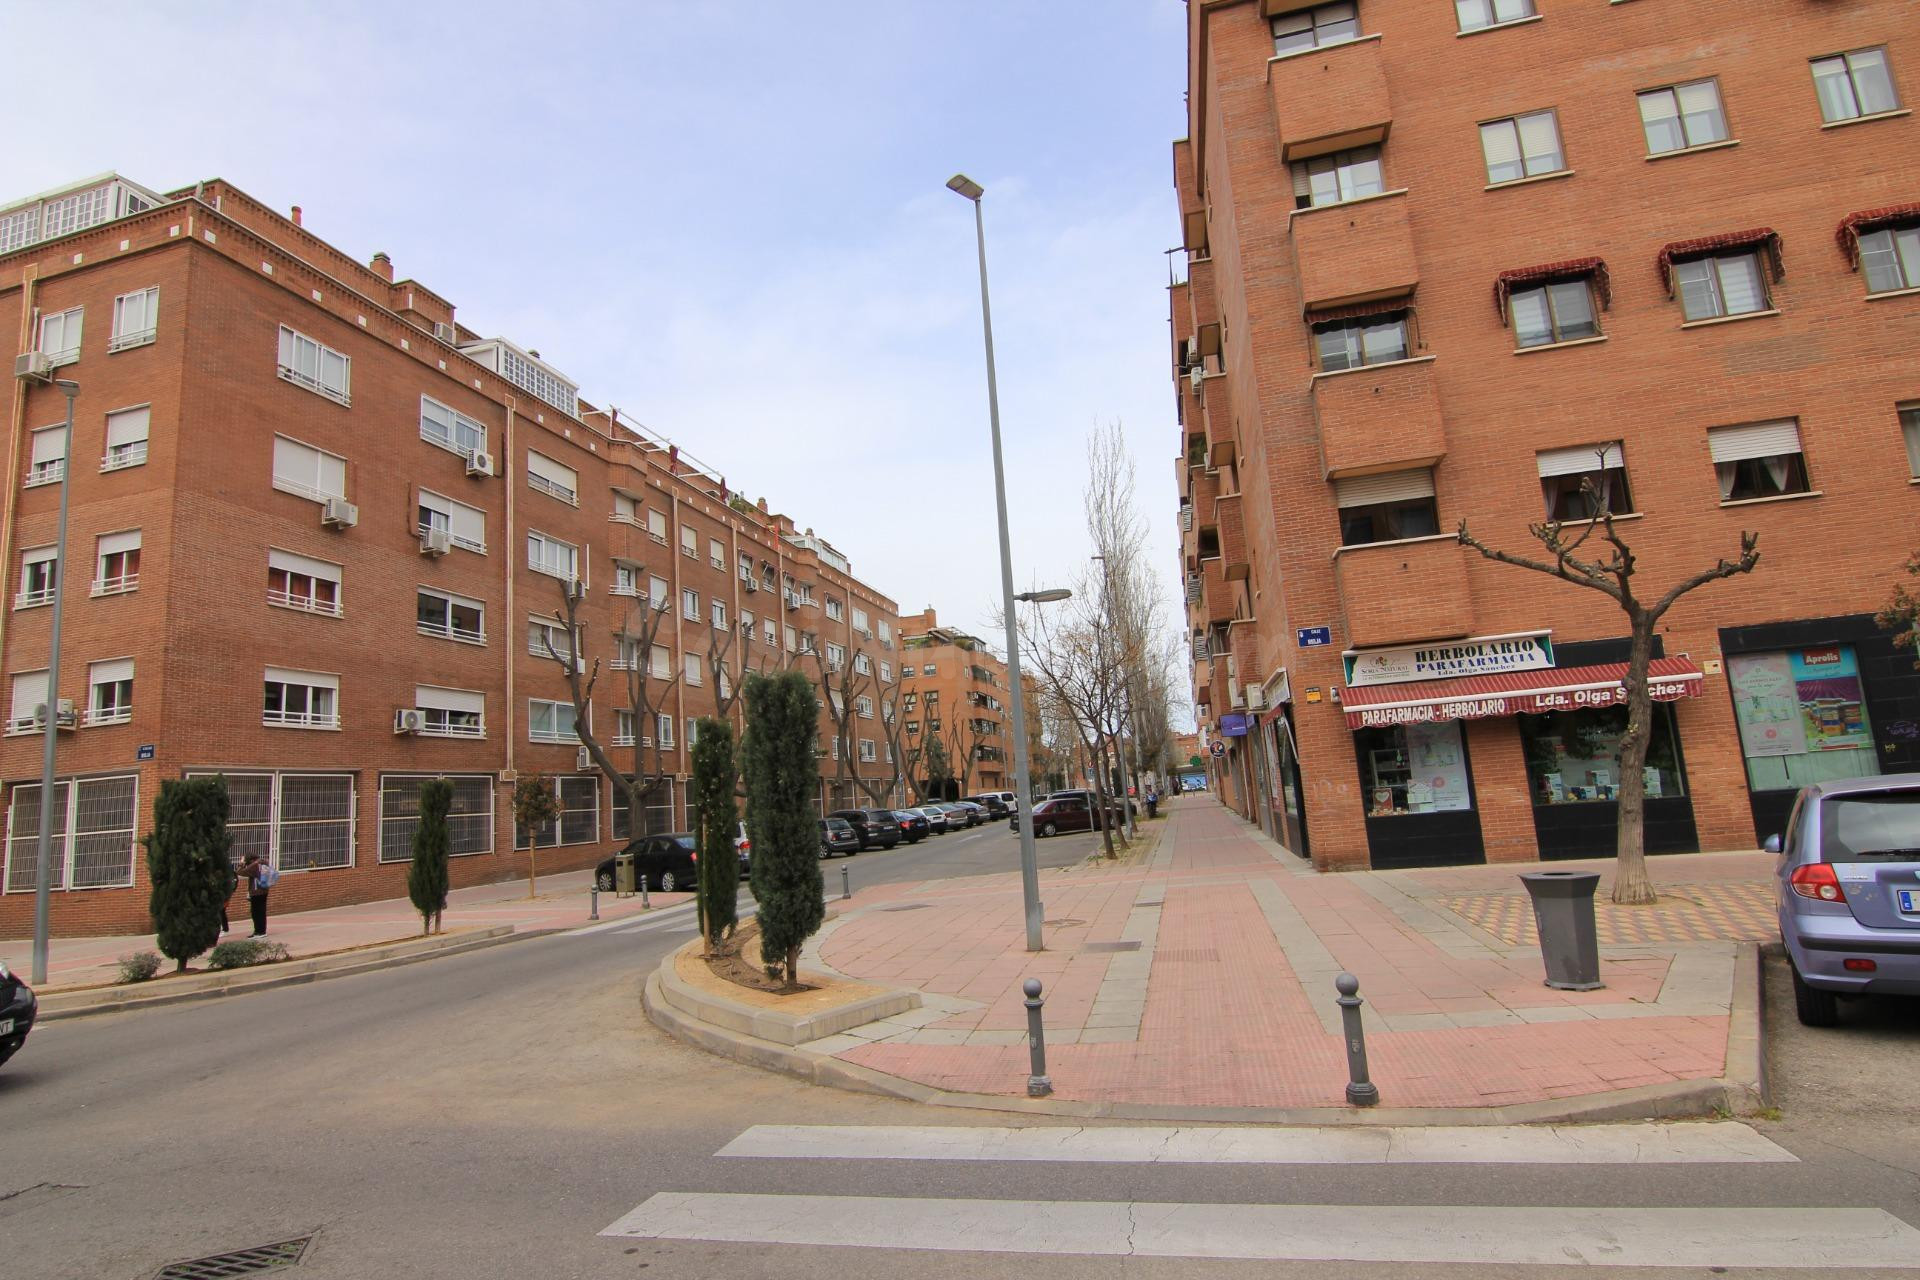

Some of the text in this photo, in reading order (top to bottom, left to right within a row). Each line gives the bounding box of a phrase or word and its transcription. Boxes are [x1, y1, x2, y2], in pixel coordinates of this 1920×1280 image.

[1416, 640, 1533, 662] HERBOLARIO
[1805, 652, 1839, 665] Aprolis
[1416, 653, 1535, 672] PARAFARMACIA
[1458, 667, 1478, 675] Olga
[1535, 683, 1685, 707] Lda. Olga Schez
[1362, 699, 1505, 725] PARAFARMACIA HERBOLARIO
